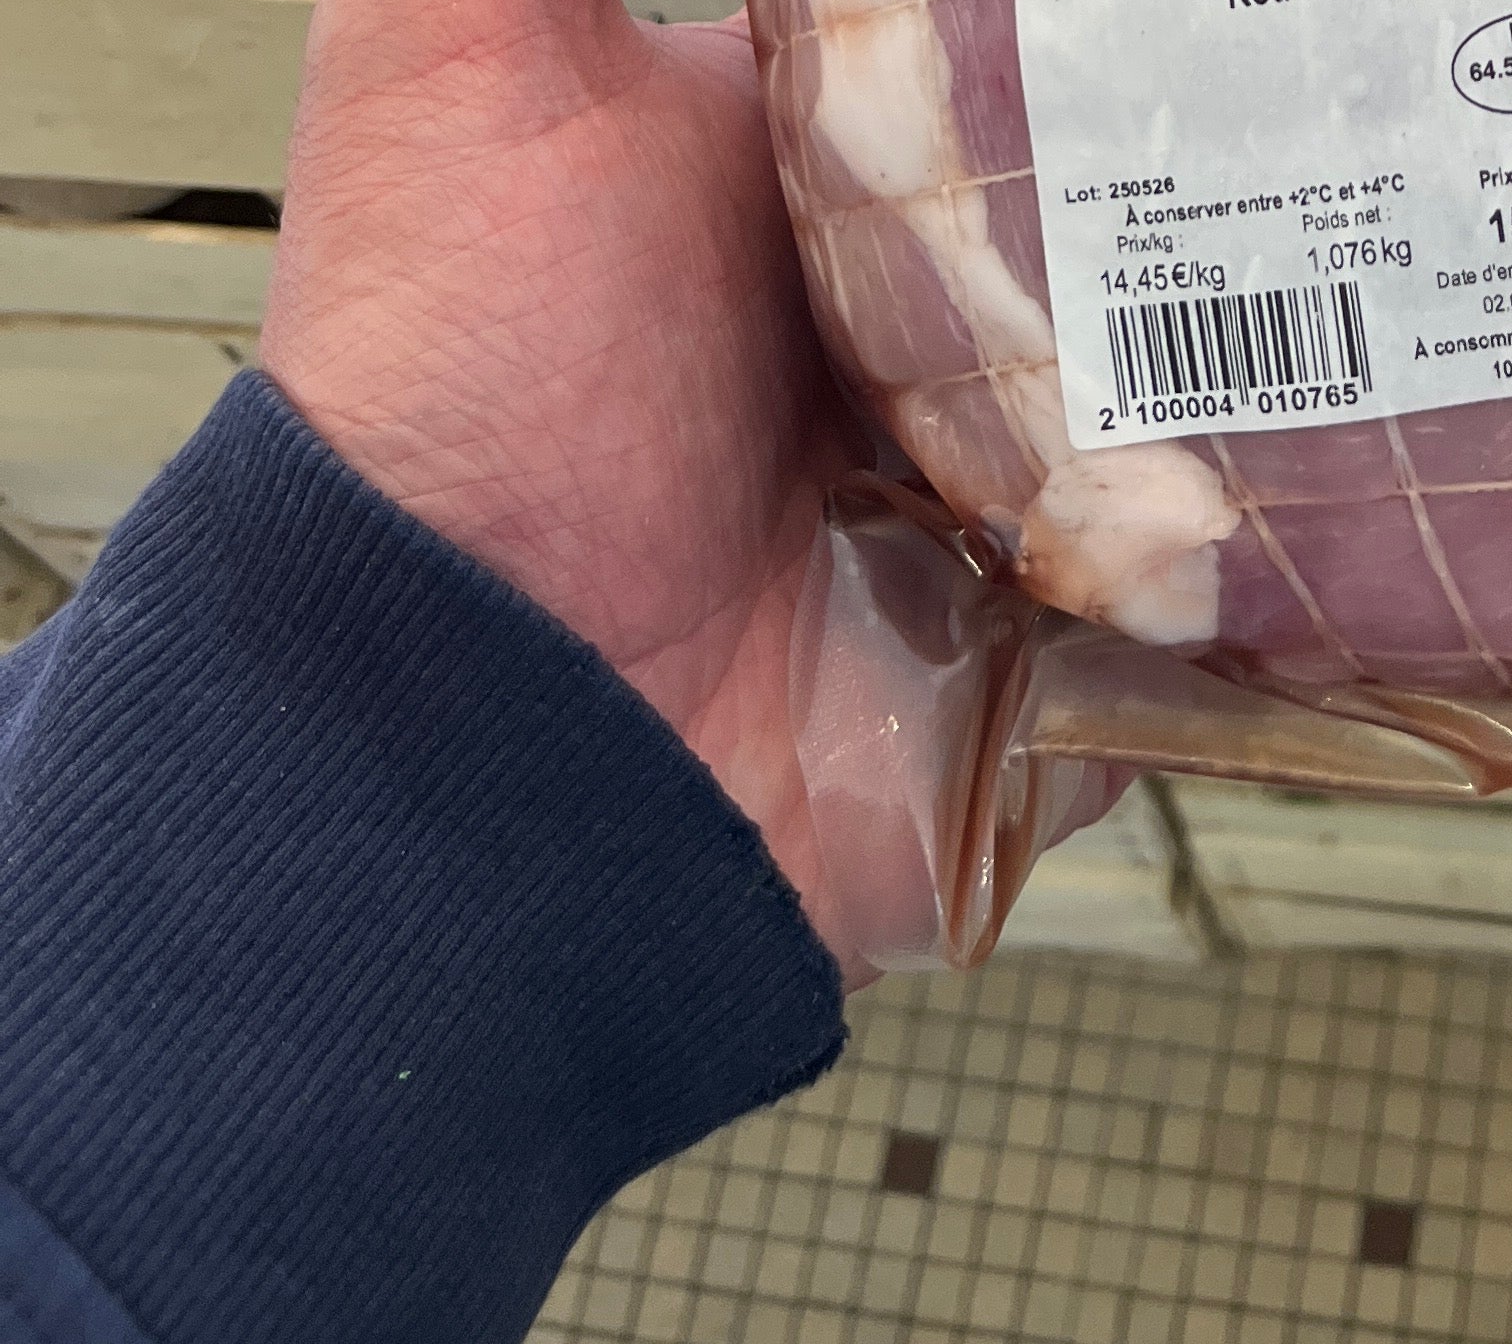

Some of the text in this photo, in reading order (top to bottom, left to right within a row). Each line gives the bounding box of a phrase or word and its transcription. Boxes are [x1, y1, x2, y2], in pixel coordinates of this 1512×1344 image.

[1065, 176, 1175, 203] Lot: 250526
[1126, 173, 1405, 227] À conserver entre +2°C et +4°C
[1302, 209, 1350, 233] Poids
[1354, 204, 1382, 226] net
[1117, 232, 1173, 253] Prix/kg
[1436, 268, 1477, 289] Date
[1414, 336, 1429, 360] À
[1099, 382, 1359, 431] 2 100004 010765
